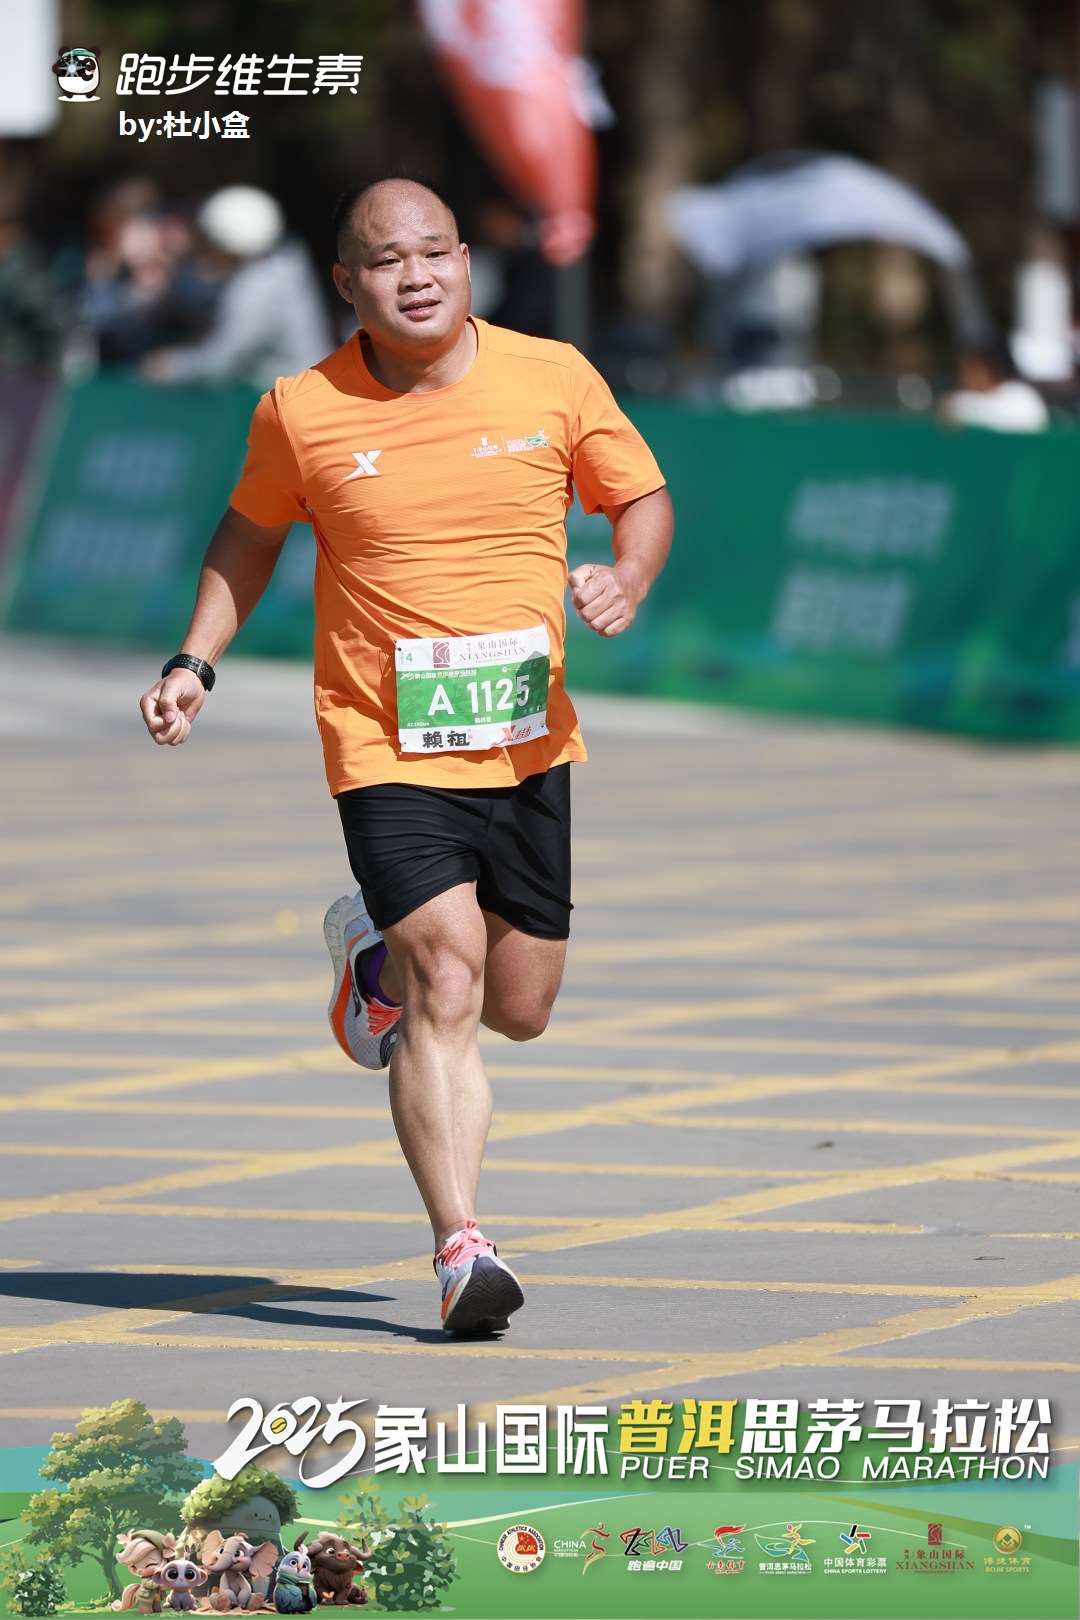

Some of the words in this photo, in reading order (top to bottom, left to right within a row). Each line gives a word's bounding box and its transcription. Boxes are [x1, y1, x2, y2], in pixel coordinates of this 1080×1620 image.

[405, 652, 413, 663] 4
[427, 683, 456, 716] A
[467, 674, 530, 714] 1125
